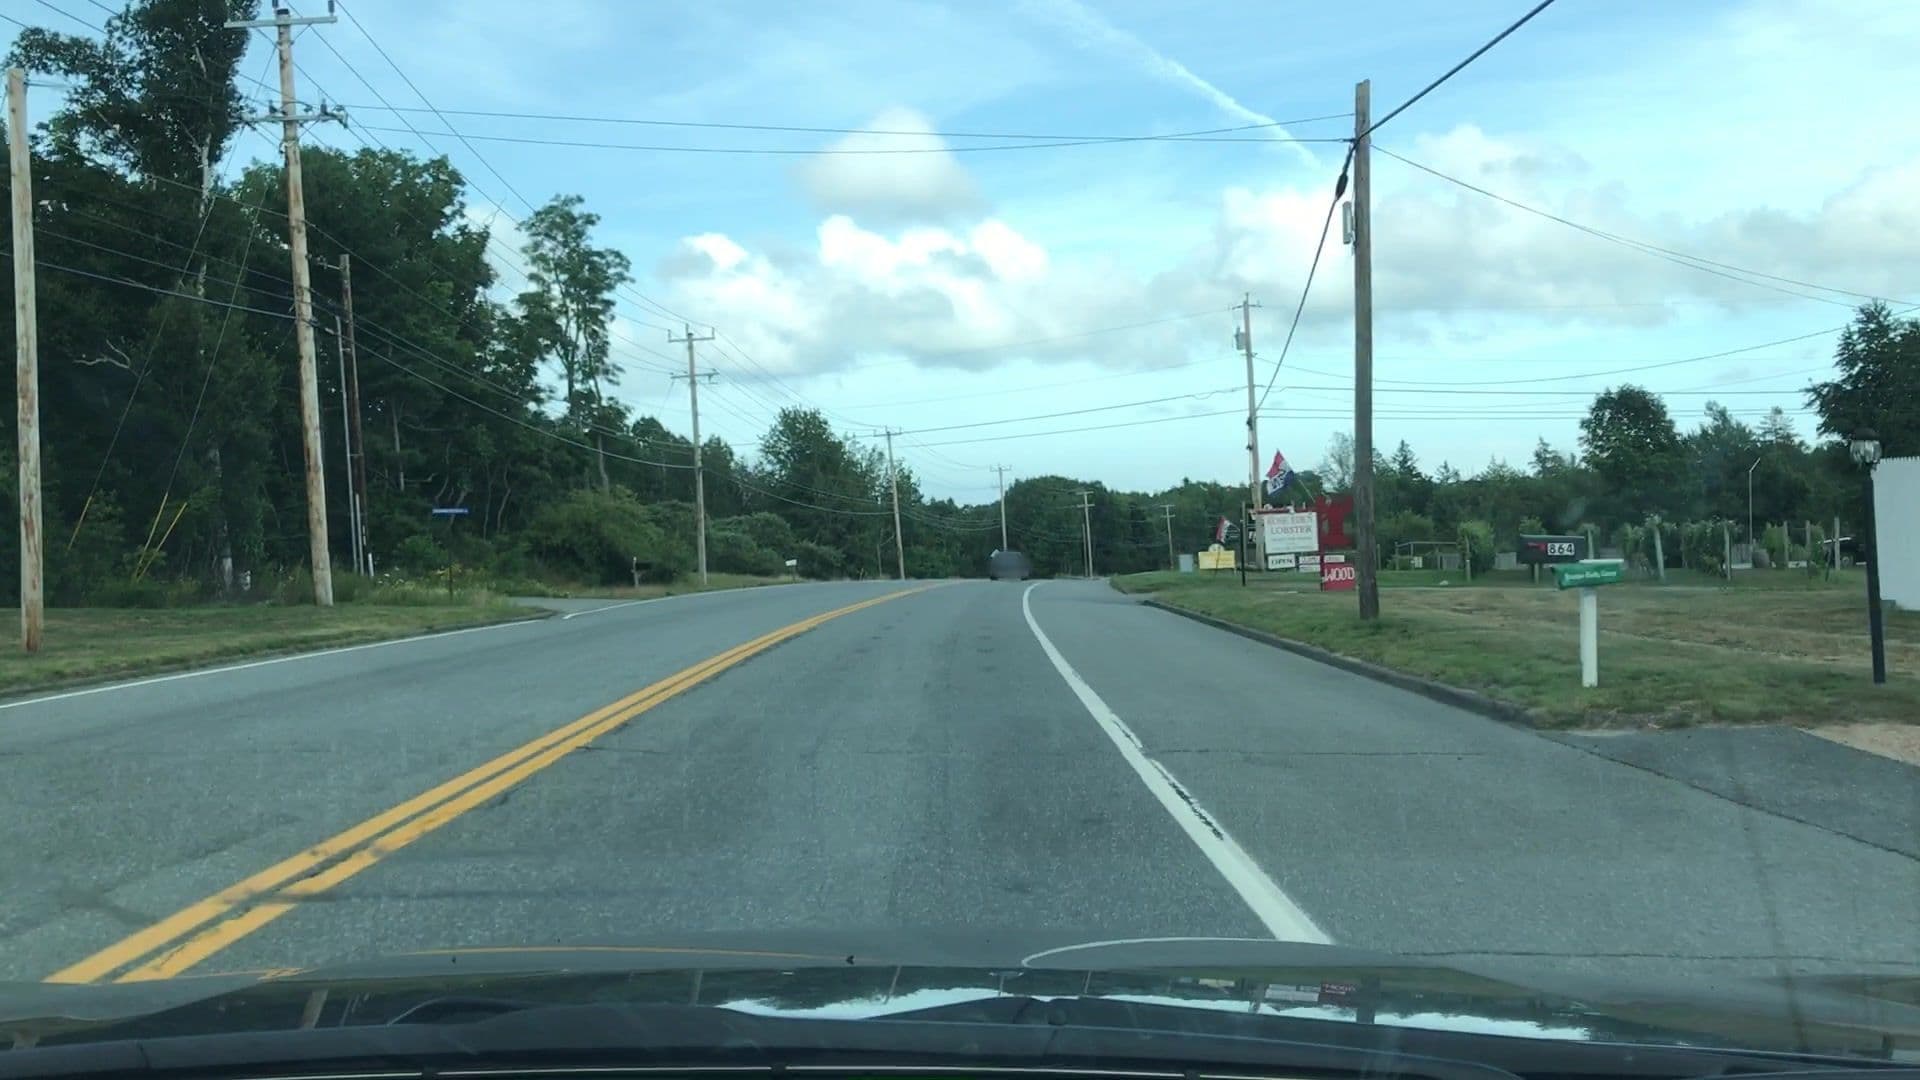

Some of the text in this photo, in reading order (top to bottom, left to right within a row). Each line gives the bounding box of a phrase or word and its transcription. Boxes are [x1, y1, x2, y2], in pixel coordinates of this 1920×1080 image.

[1271, 525, 1313, 535] LOBSTER
[1549, 543, 1573, 554] 864
[1322, 566, 1355, 583] WOOD
